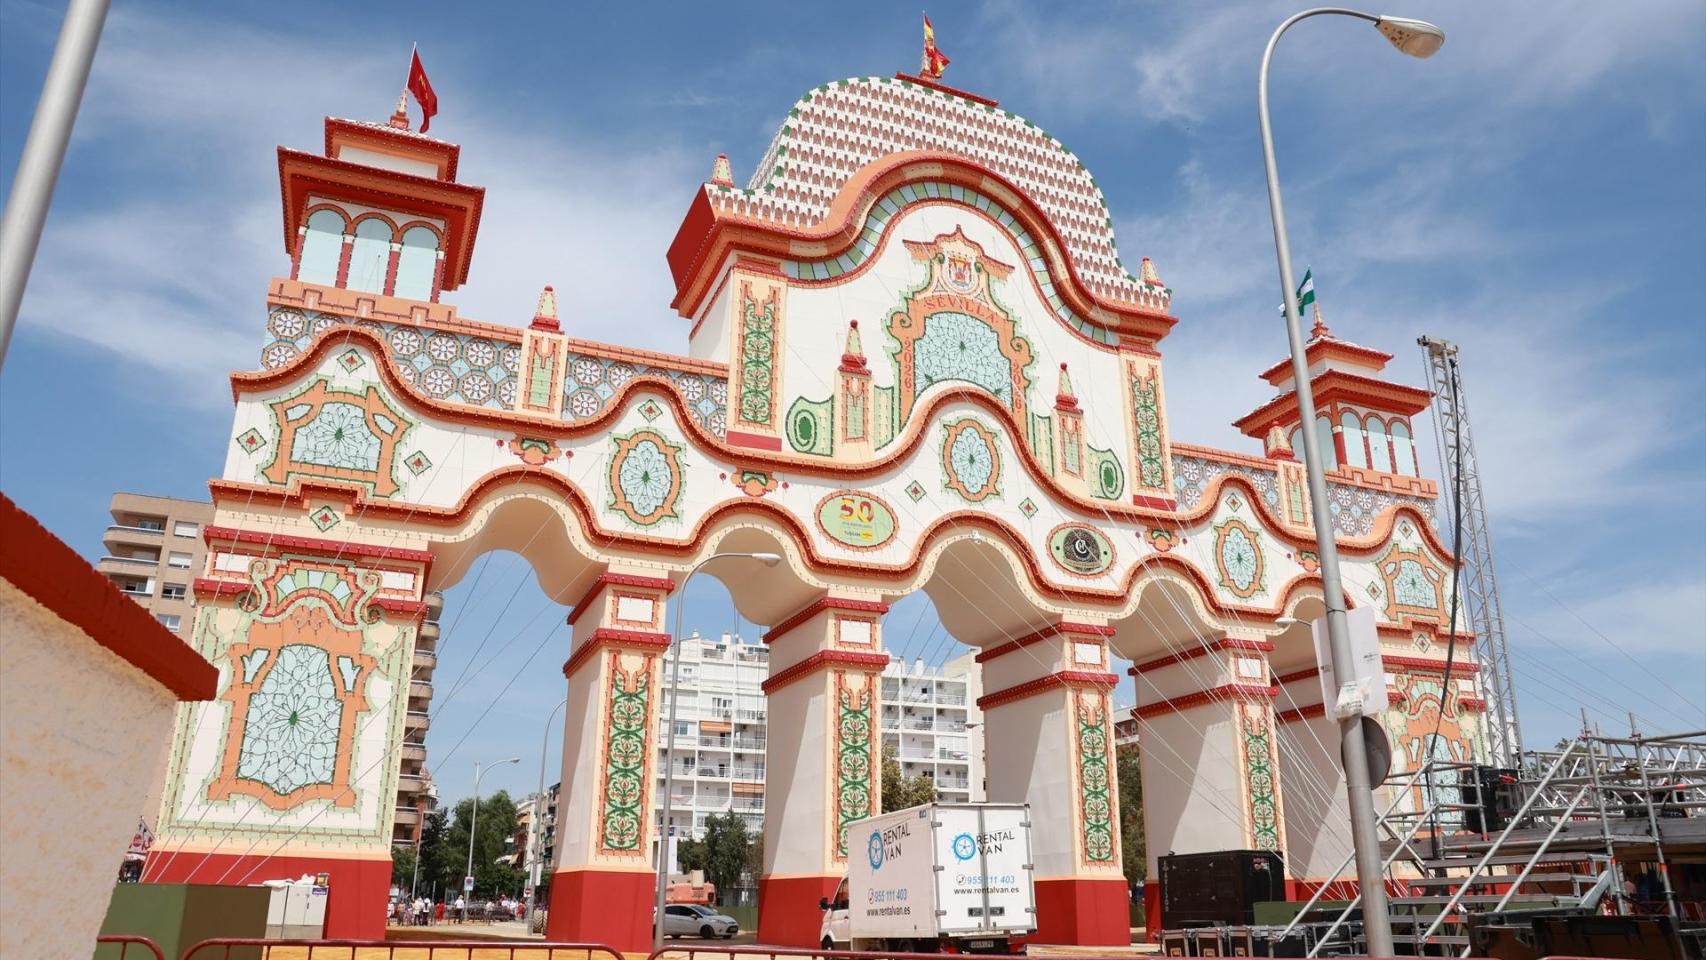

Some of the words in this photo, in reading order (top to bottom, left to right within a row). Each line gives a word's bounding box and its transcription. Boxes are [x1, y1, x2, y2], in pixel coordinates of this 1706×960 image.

[904, 340, 912, 389] 2026
[840, 497, 874, 523] 50
[883, 822, 911, 847] RENTAL
[976, 830, 1015, 845] RENTAL
[884, 842, 902, 861] VAN
[977, 843, 1003, 856] VAN
[966, 875, 982, 885] 955
[1000, 874, 1015, 884] 403
[874, 890, 885, 903] 955
[953, 886, 1020, 895] www.rentalvan.es
[866, 905, 911, 917] www.rentalvan.es
